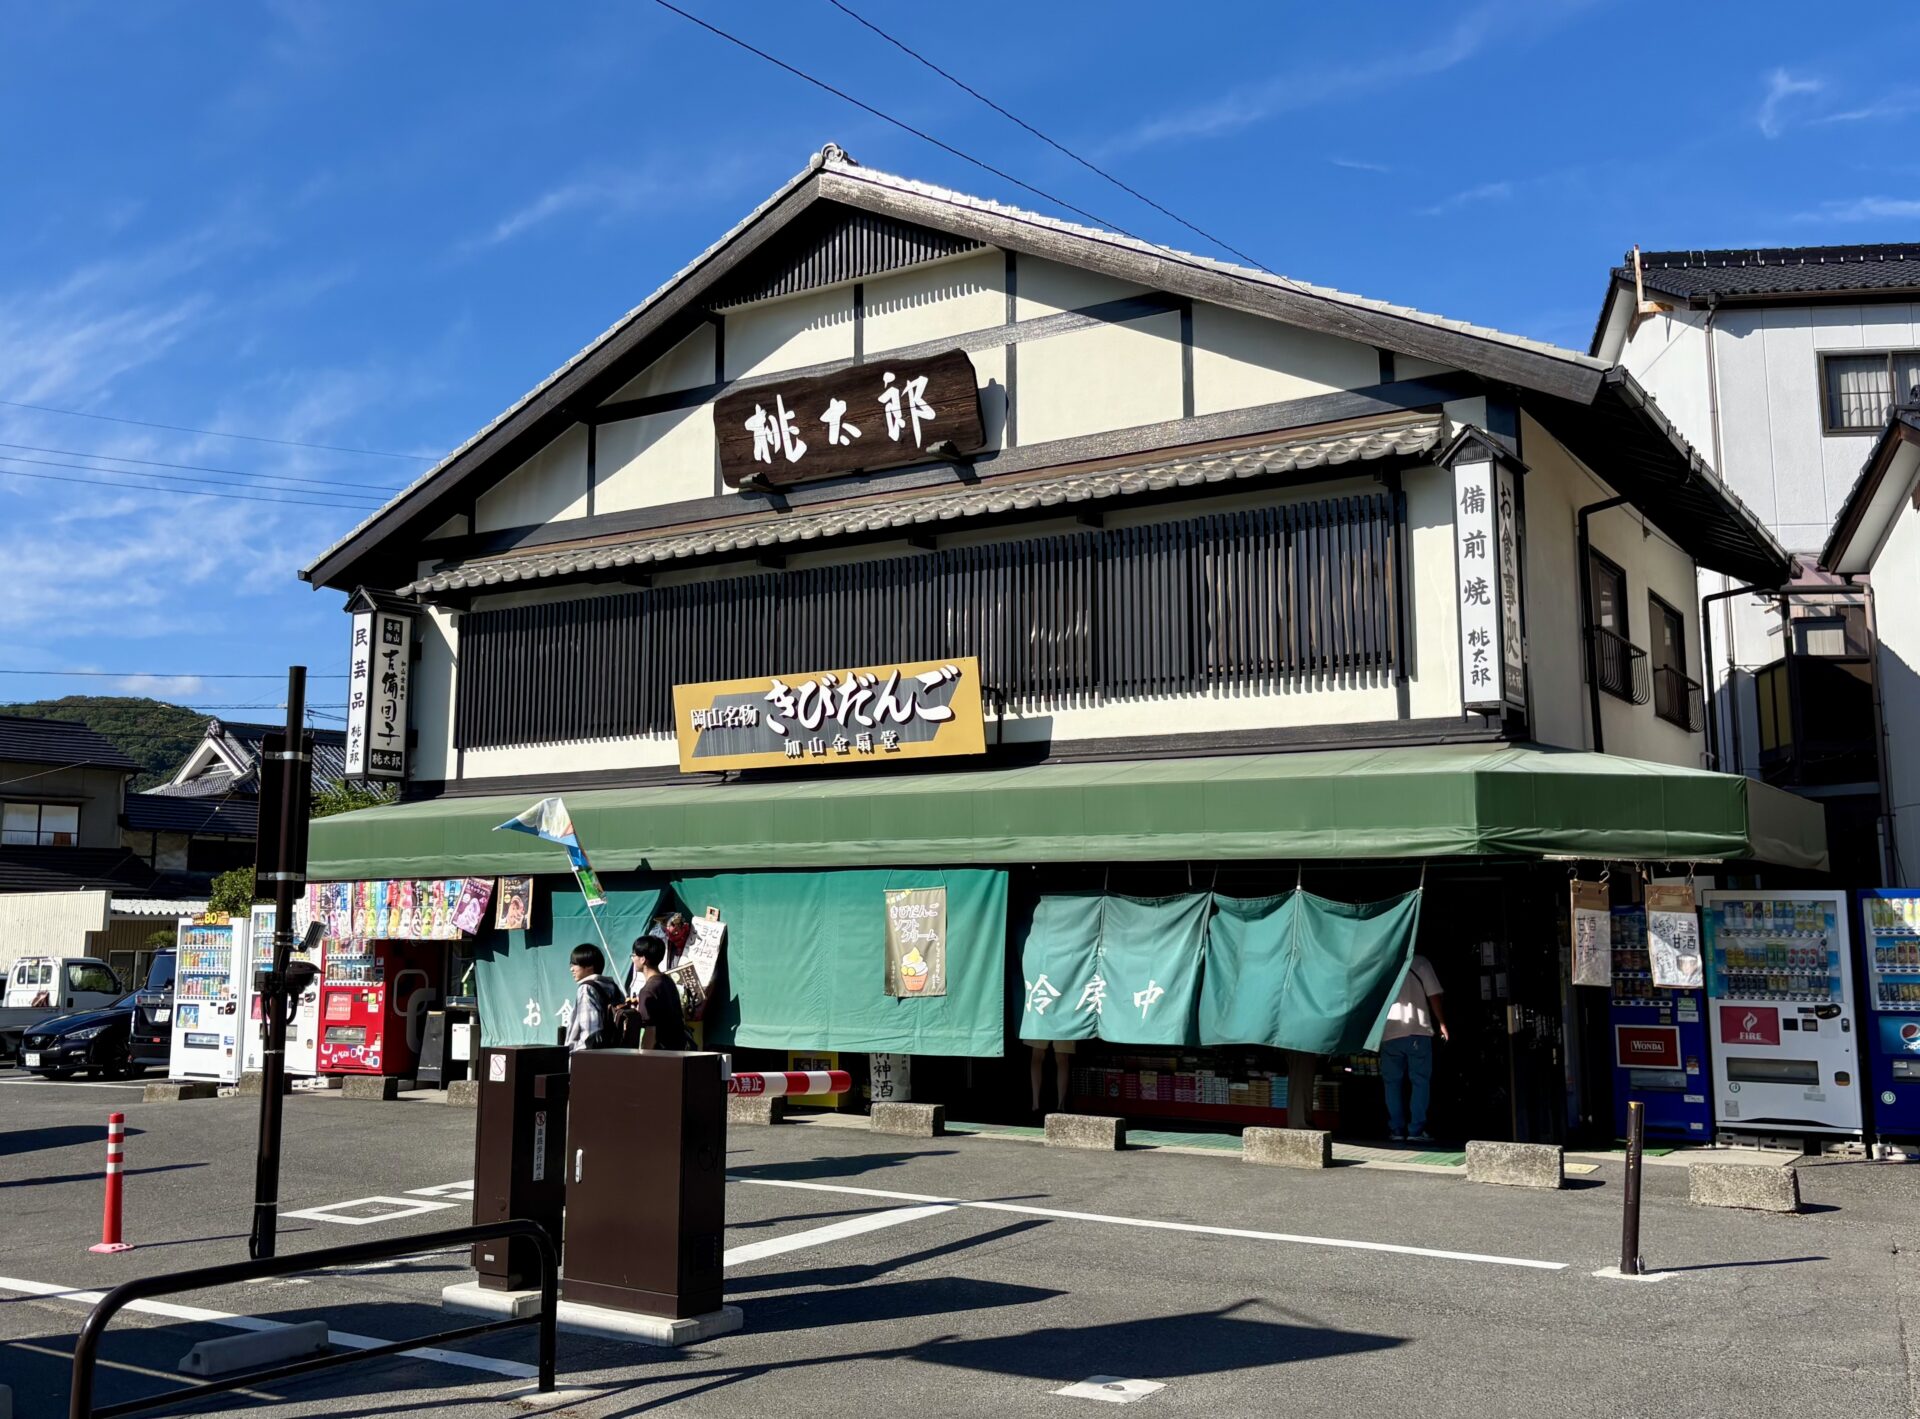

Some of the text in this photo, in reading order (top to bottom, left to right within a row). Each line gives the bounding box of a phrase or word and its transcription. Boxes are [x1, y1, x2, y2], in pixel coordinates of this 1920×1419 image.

[744, 371, 936, 464] 桃太郎
[1459, 485, 1491, 607] 備前焼
[1500, 482, 1519, 660] お食事処
[352, 628, 368, 711] 民芸品
[1468, 629, 1492, 688] 桃太郎
[378, 649, 400, 746] 吉備団子
[690, 703, 758, 731] 岡山名物
[764, 664, 960, 735] きびだんご
[350, 724, 362, 766] 桃太郎
[784, 729, 899, 757] 加山金扇堂
[204, 912, 217, 925] 80
[890, 902, 940, 919] きびだんご
[1025, 973, 1165, 1019] 冷房中
[1632, 1041, 1662, 1051] WONDA
[1739, 1031, 1762, 1041] FIRE
[727, 1077, 762, 1092] 入禁止
